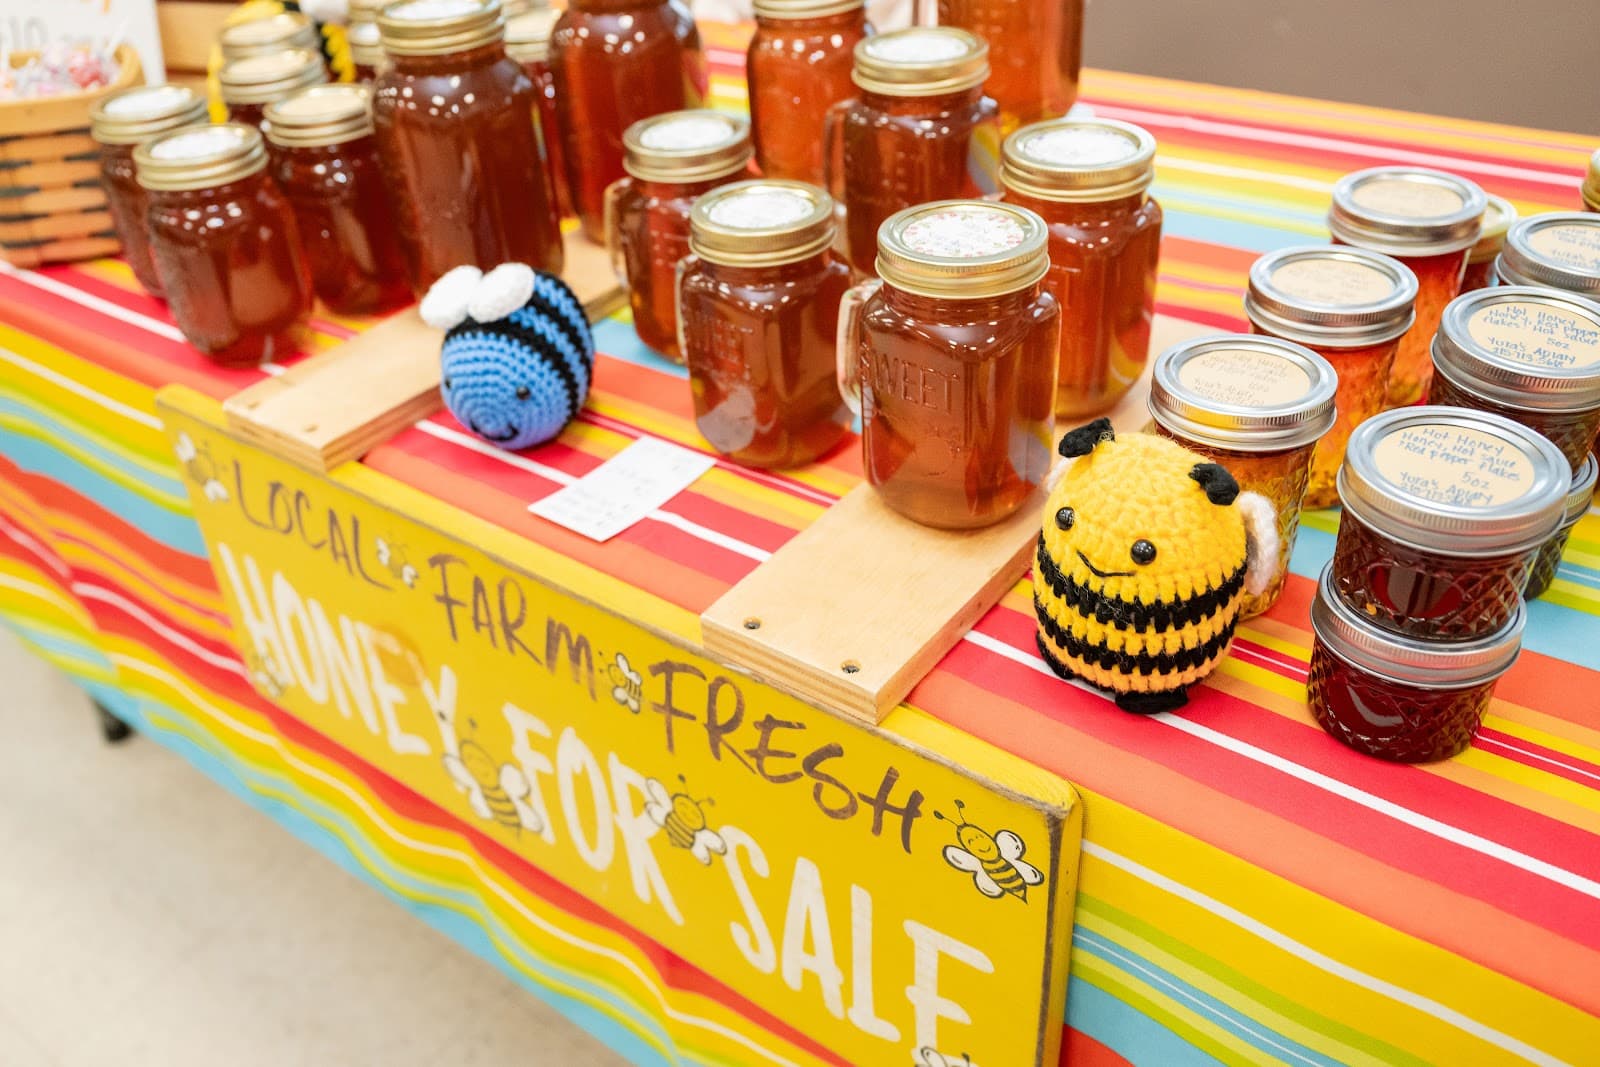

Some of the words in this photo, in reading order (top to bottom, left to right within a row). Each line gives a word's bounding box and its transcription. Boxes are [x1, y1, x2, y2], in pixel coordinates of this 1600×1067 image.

[1423, 428, 1449, 440] Hot
[1457, 434, 1504, 456] Honey
[1452, 444, 1476, 457] Hot
[1461, 471, 1490, 490] 5oz
[1445, 484, 1494, 505] Apiary
[232, 458, 396, 592] LOCAL
[648, 658, 925, 855] FRESH
[218, 541, 492, 819] HONEY
[502, 702, 685, 925] FOR
[716, 825, 995, 1067] SALE
